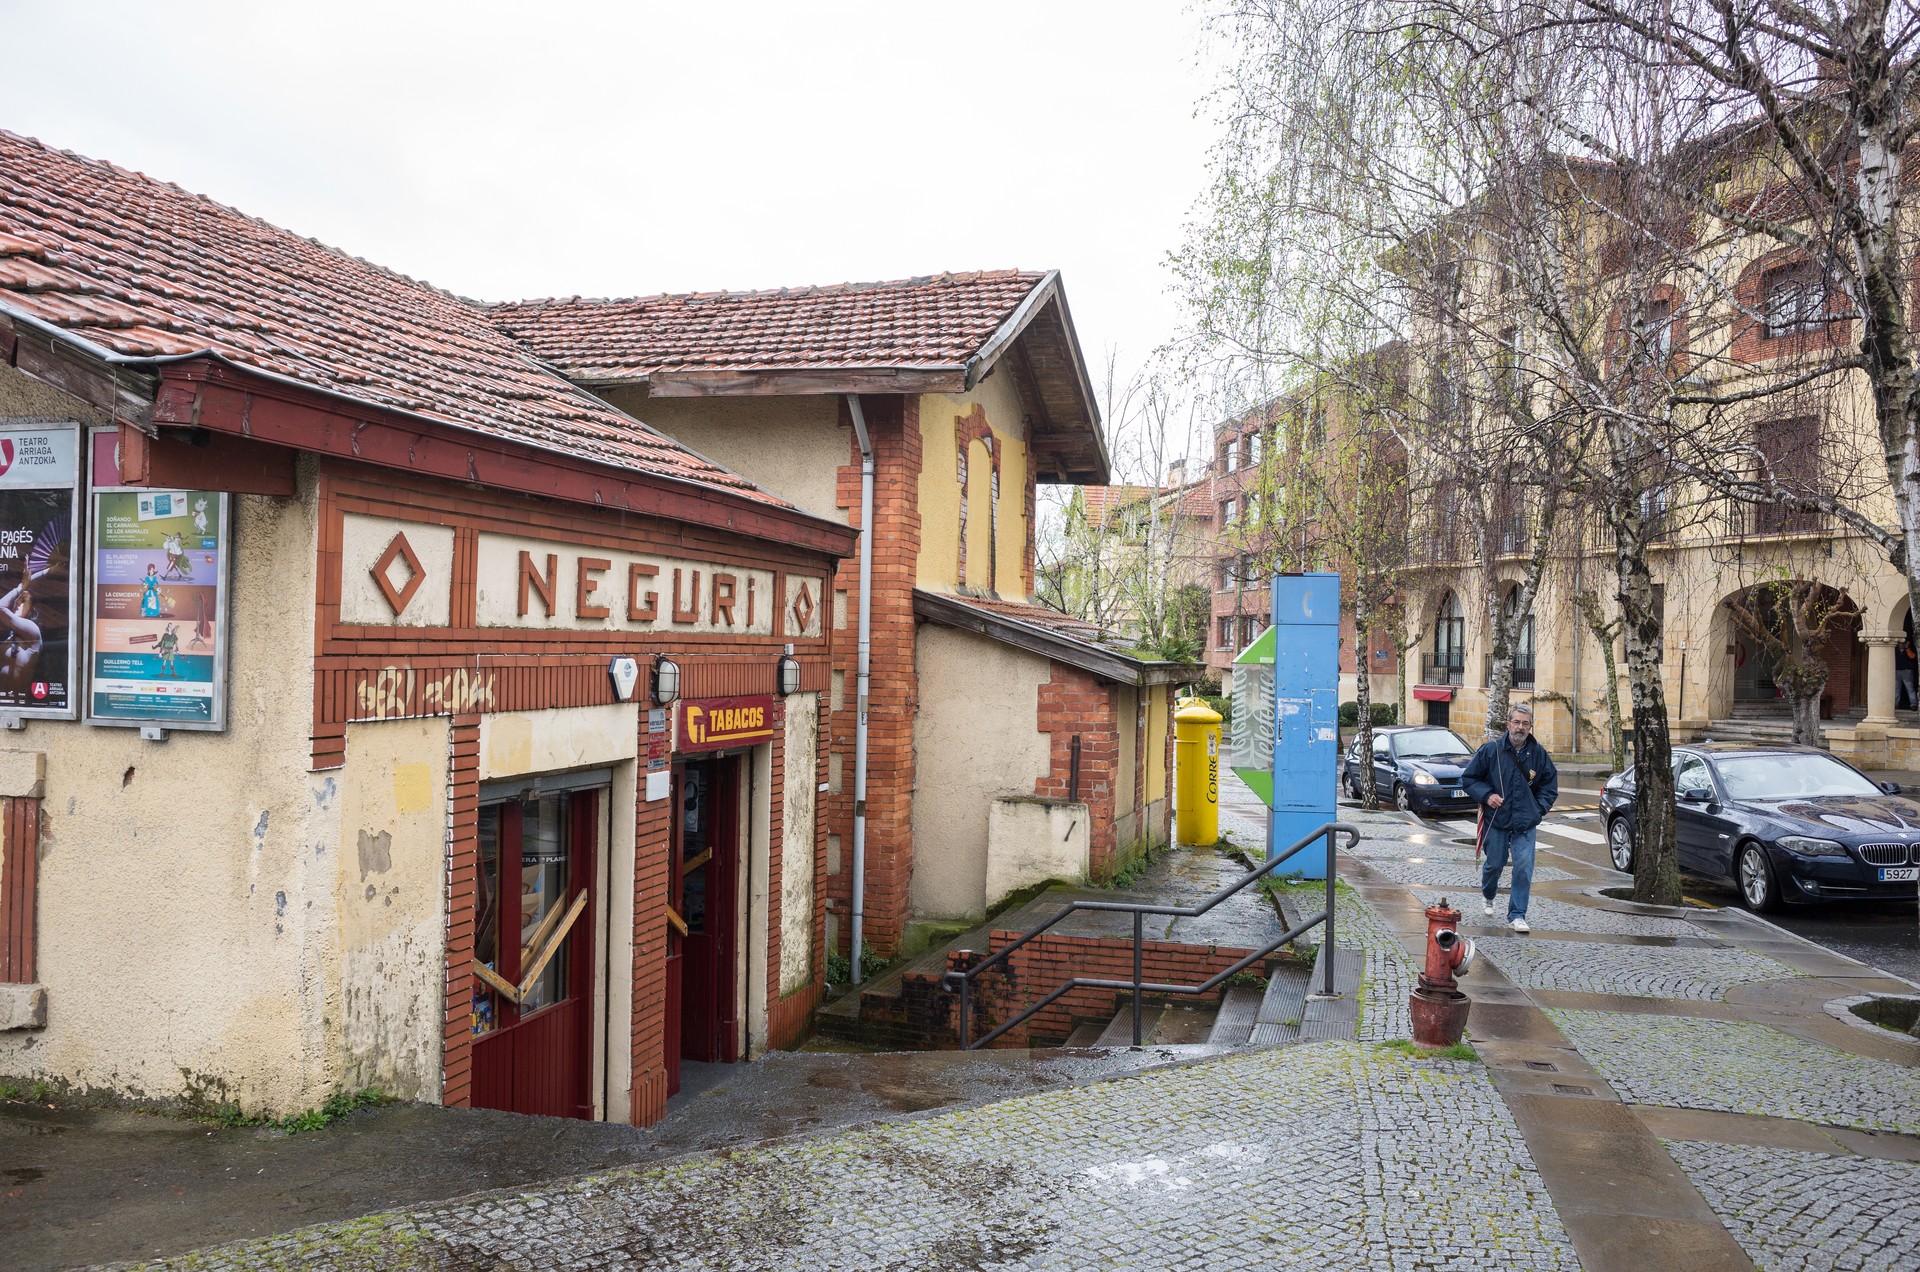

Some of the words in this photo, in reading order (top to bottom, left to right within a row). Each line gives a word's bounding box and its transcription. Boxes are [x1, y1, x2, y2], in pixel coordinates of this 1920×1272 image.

[19, 437, 48, 446] TEATRO
[19, 447, 52, 456] ARRIAGA
[19, 456, 56, 465] ANTZOKIA
[1, 526, 33, 543] PAGÉS
[0, 542, 19, 559] ÑÍA
[709, 706, 764, 732] TABACOS
[1886, 869, 1913, 880] 5927
